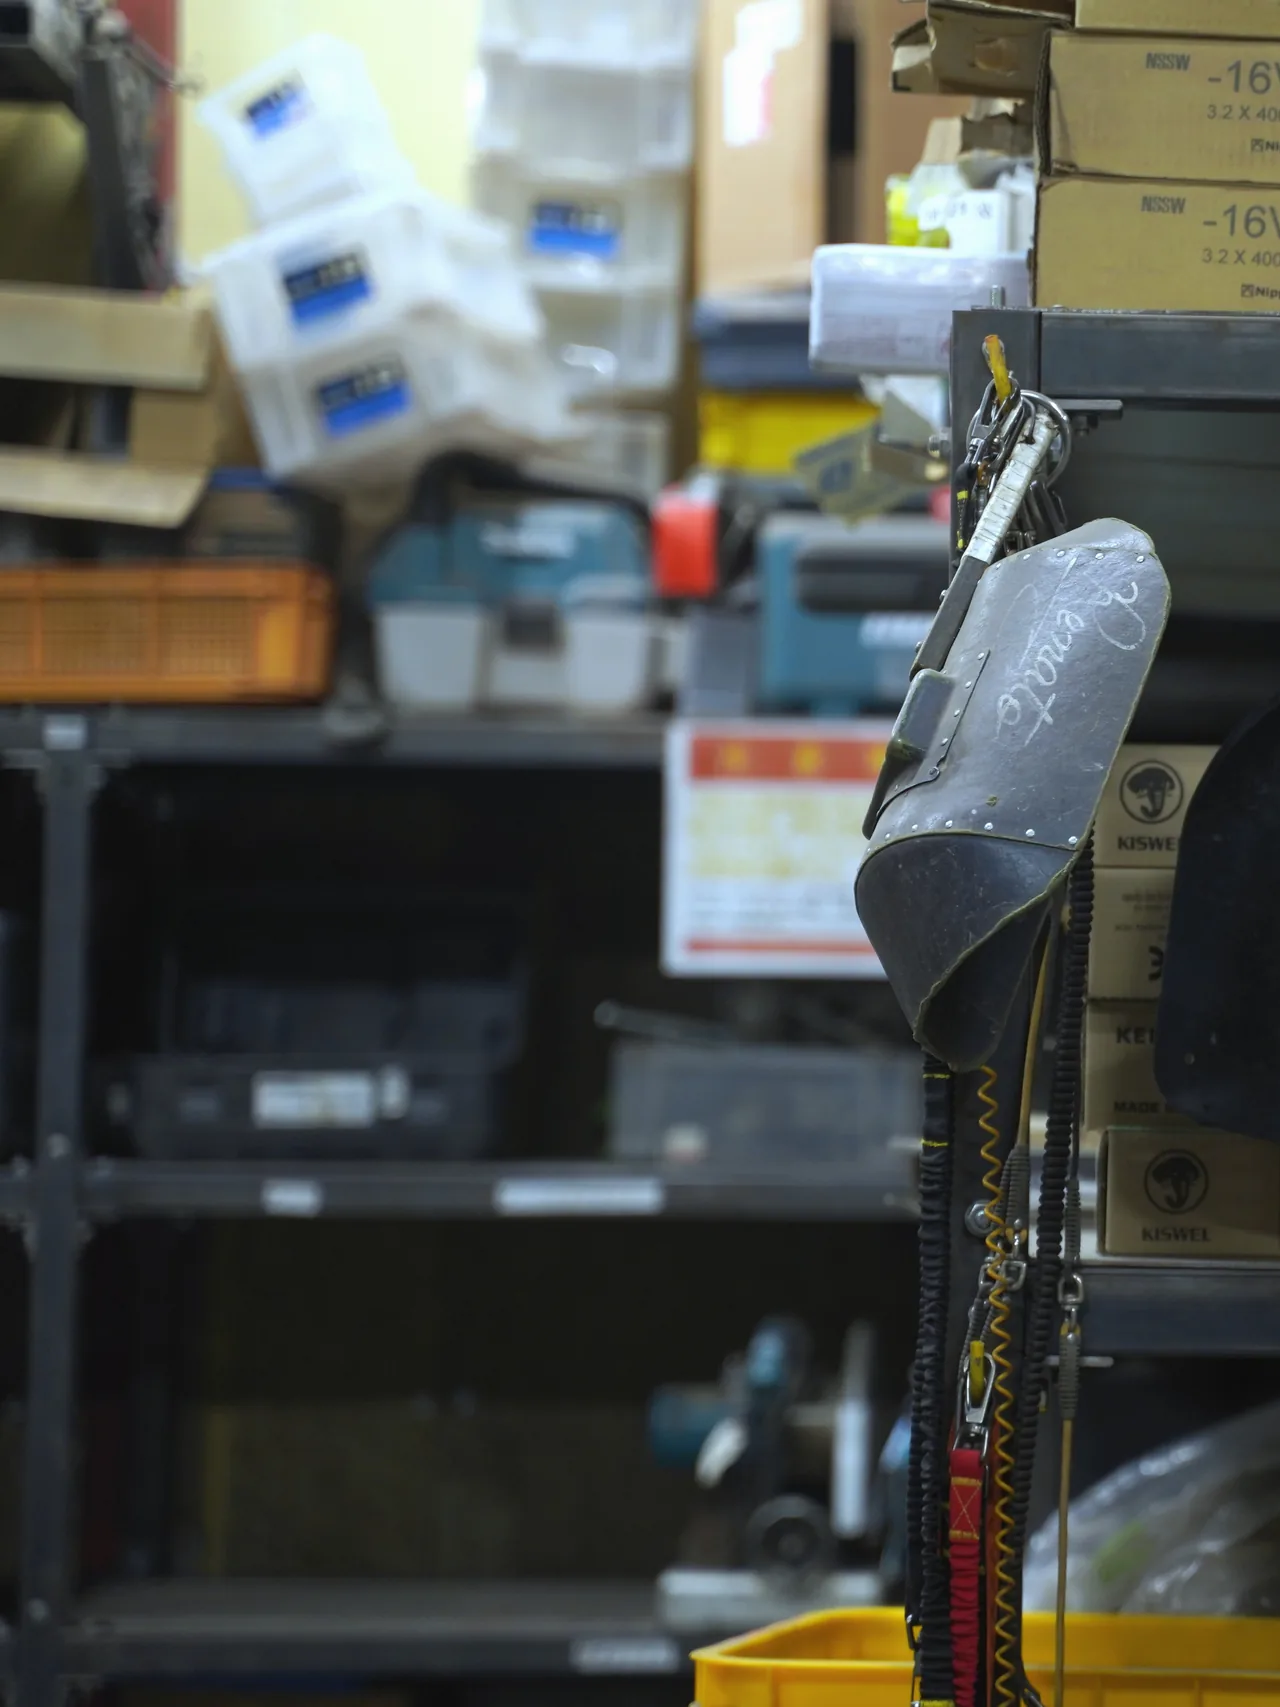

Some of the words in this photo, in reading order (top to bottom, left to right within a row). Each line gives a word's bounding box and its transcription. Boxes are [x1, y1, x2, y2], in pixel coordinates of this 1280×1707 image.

[1145, 53, 1191, 71] NSSW
[1141, 196, 1186, 214] NSSW
[1117, 836, 1179, 851] KISWE
[1116, 1027, 1155, 1044] KE
[1113, 1101, 1161, 1113] MADE
[1141, 1227, 1212, 1242] KISWEL
